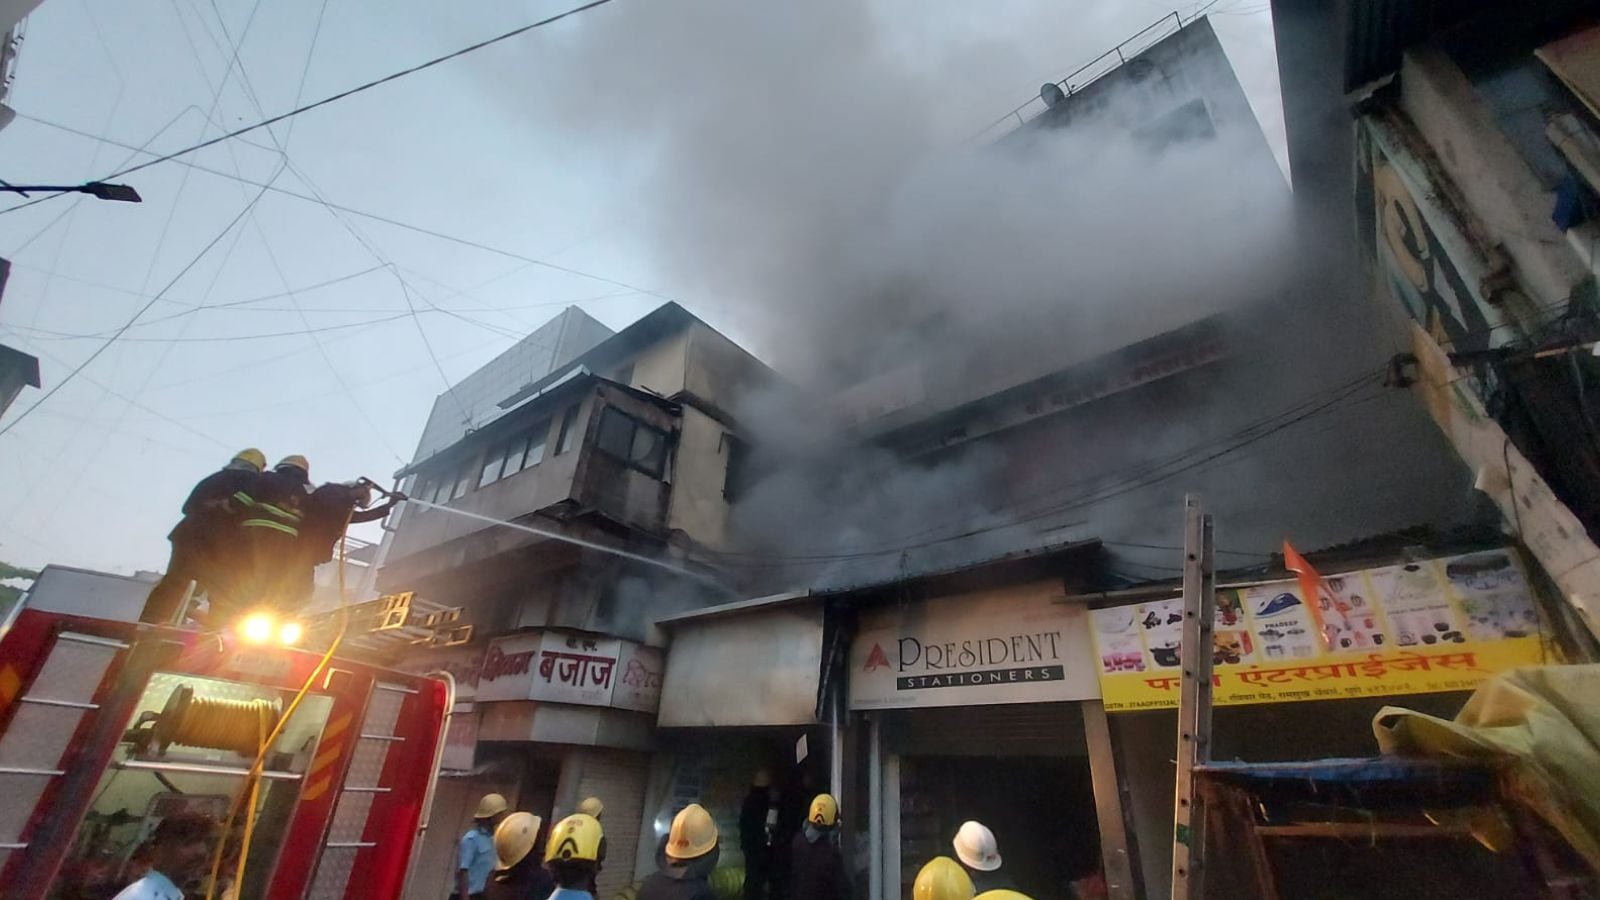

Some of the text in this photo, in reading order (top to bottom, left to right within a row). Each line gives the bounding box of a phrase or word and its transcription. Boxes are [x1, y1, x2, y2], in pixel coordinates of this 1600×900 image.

[538, 649, 616, 689] बजाज
[898, 631, 1062, 672] PRESIDENT
[906, 667, 1051, 689] STATIONERS
